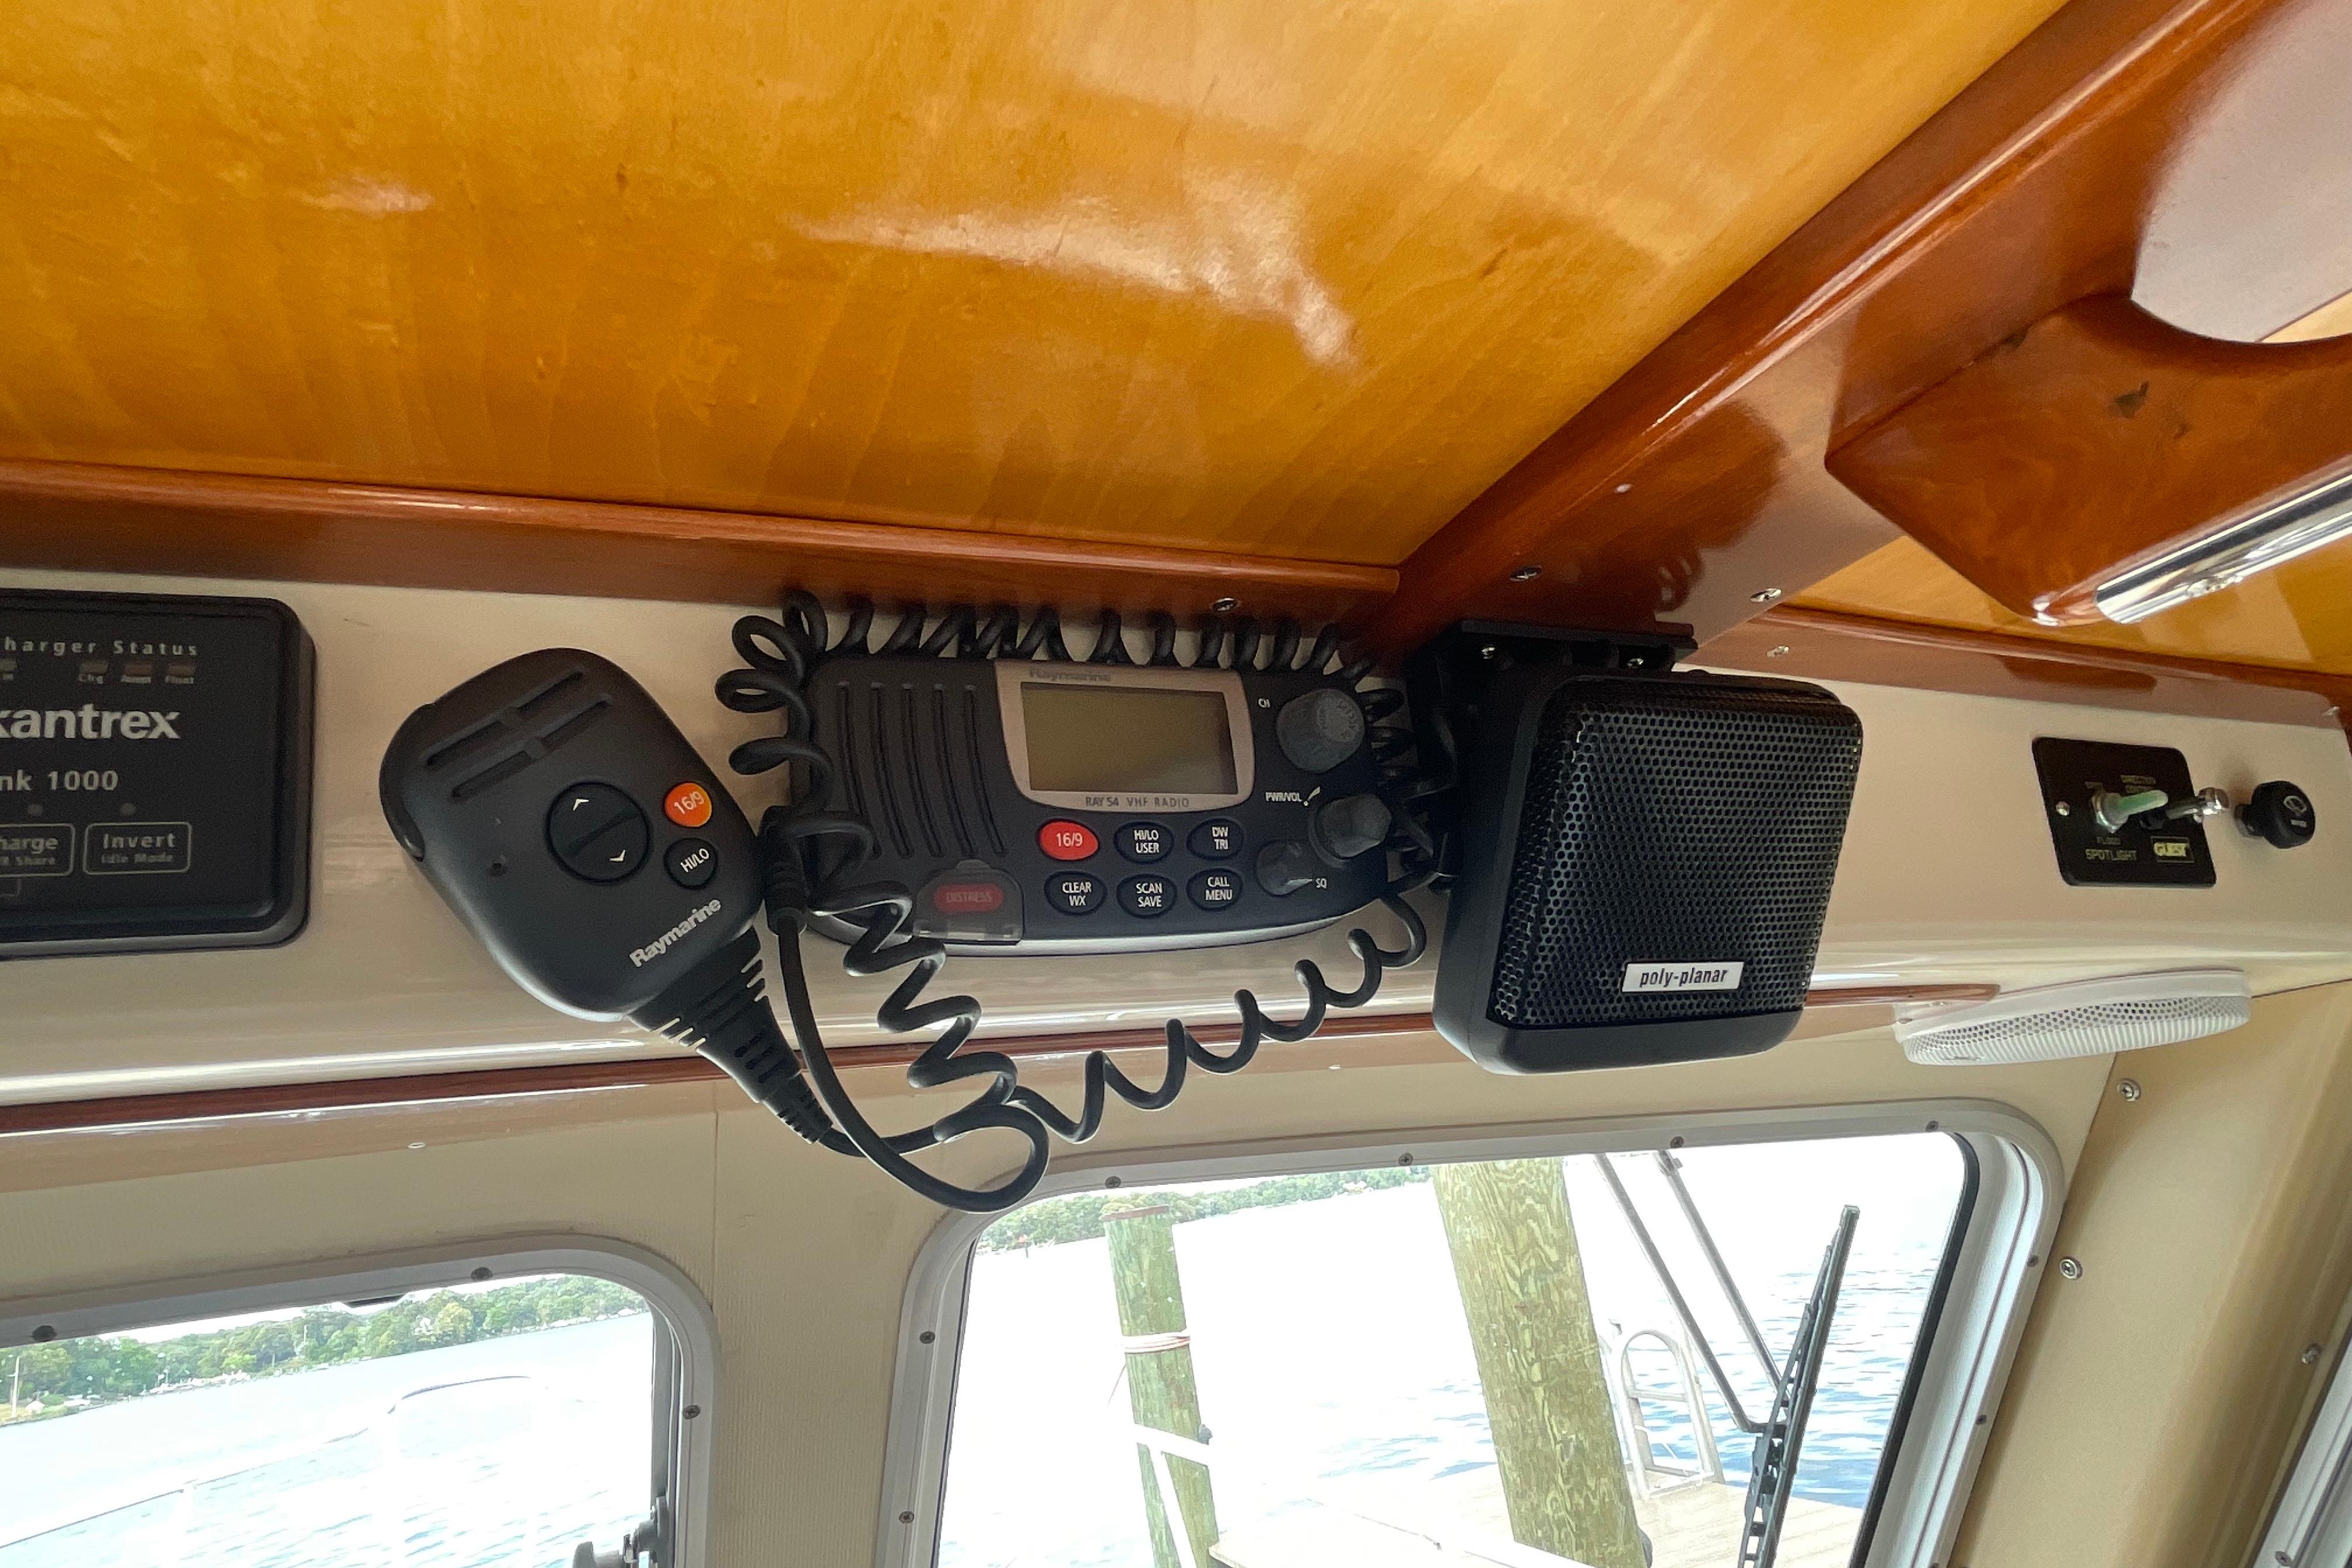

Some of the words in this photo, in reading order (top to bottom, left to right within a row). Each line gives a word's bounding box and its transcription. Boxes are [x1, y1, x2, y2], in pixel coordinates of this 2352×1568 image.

[113, 640, 197, 656] Status
[1258, 698, 1270, 708] CH
[47, 770, 118, 790] 1000
[674, 790, 705, 815] 16/9
[1126, 797, 1149, 807] VHF
[1154, 797, 1189, 808] RADIO
[1133, 830, 1159, 841] HI/LO
[1212, 826, 1228, 838] DW
[103, 833, 174, 849] Invert
[1056, 832, 1083, 847] 16/9
[1214, 838, 1229, 850] TRI
[1135, 842, 1160, 853] USER
[1062, 882, 1093, 894] CLEAR
[1135, 882, 1163, 894] SCAN
[1208, 877, 1230, 887] CALL
[1315, 878, 1327, 888] SQ
[946, 891, 993, 904] DISTRESS
[1069, 895, 1087, 907] WX
[1138, 895, 1162, 908] SAVE
[1205, 890, 1233, 901] MENU
[629, 900, 721, 968] Raymarine
[1639, 967, 1728, 988] poly-planar
